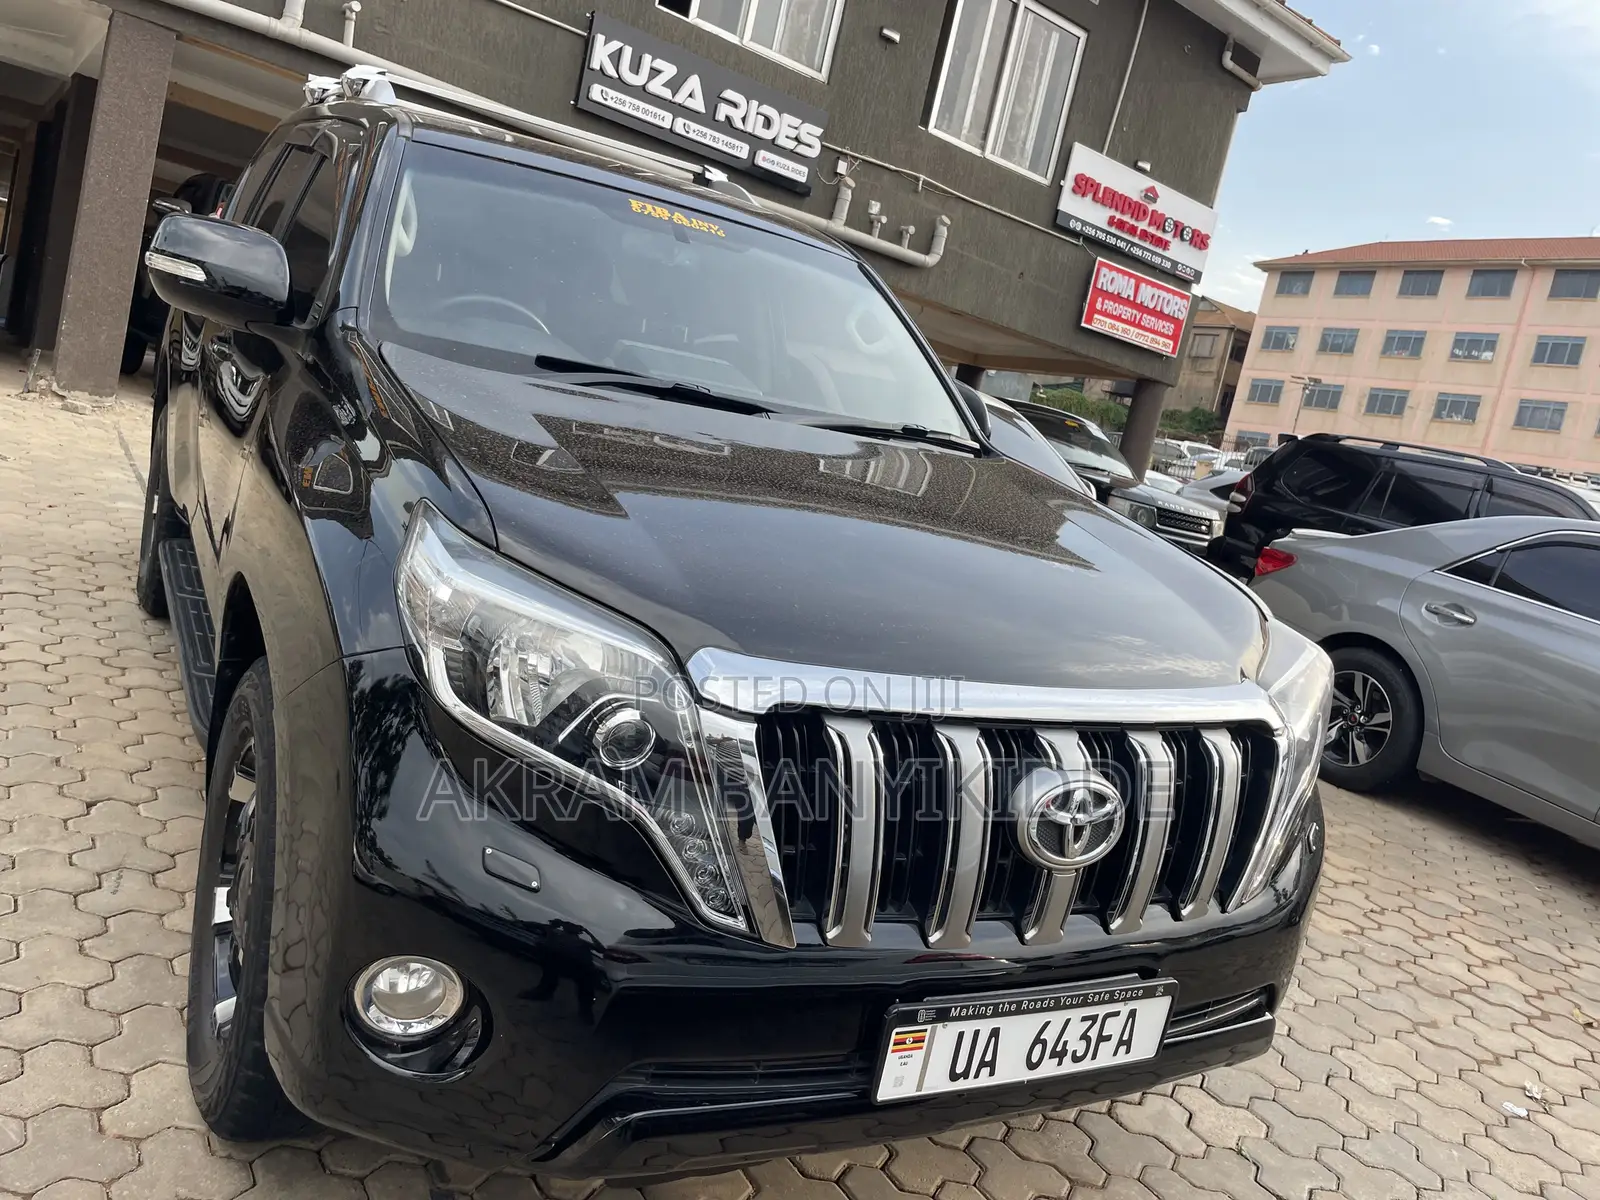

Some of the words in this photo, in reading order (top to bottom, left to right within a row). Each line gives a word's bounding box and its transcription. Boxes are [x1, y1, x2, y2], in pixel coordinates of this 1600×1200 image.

[589, 33, 706, 114] KUZA
[715, 88, 824, 158] RIDES
[610, 95, 627, 109] +256
[627, 101, 641, 114] 758
[641, 105, 666, 123] 001614
[692, 128, 707, 141] +256
[707, 133, 721, 146] 783
[721, 138, 743, 154] 145817
[776, 159, 790, 173] KUZA
[790, 165, 806, 178] RIDES
[1072, 173, 1149, 222] SPLENDID
[1148, 209, 1211, 251] MOTORS
[1082, 225, 1096, 237] +256
[1096, 267, 1136, 301] ROMA
[1136, 282, 1188, 320] MOTORS
[1095, 297, 1102, 310] &
[1102, 299, 1142, 324] PROPERTY
[1140, 313, 1175, 336] SERVICES
[950, 1006, 994, 1018] Making
[998, 1001, 1017, 1013] the
[1021, 997, 1055, 1010] Roads
[1059, 994, 1084, 1006] Your
[1087, 991, 1110, 1003] Safe
[1113, 988, 1144, 1002] Space
[949, 1026, 1001, 1082] UA
[1025, 1007, 1138, 1072] 643FA
